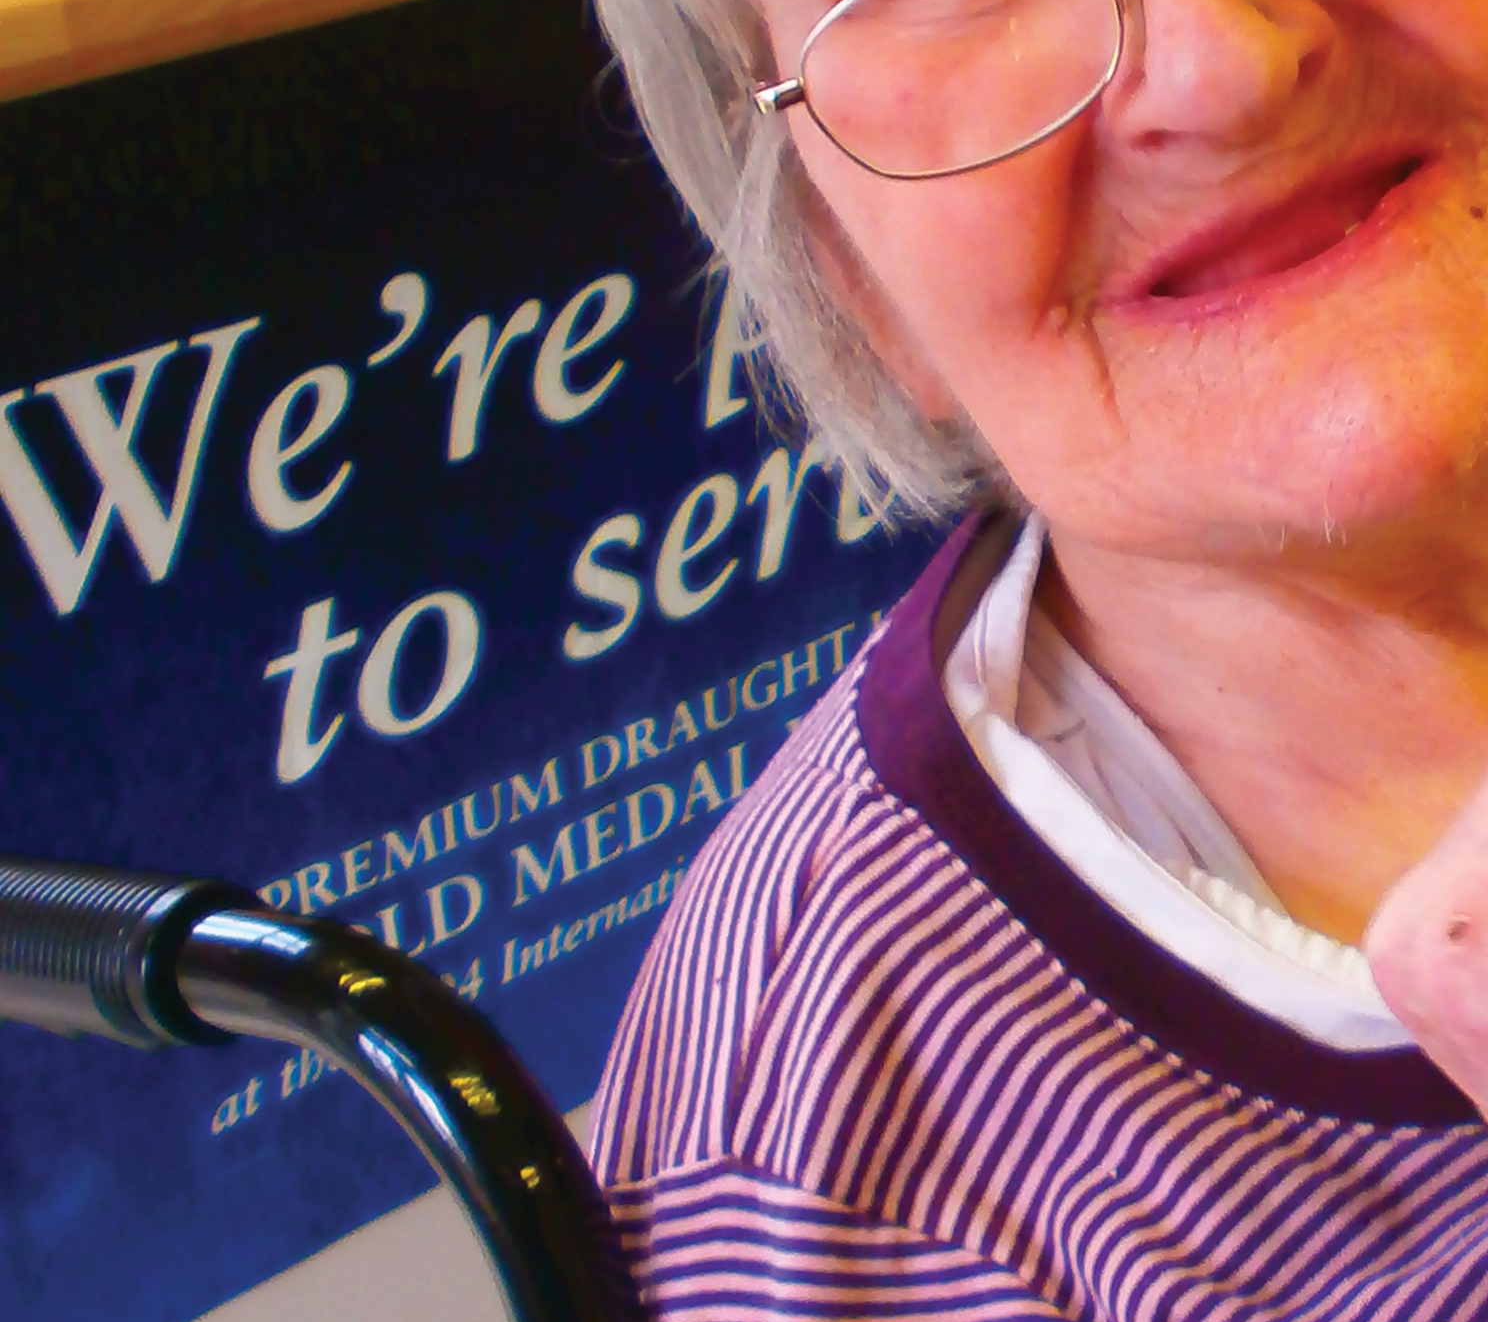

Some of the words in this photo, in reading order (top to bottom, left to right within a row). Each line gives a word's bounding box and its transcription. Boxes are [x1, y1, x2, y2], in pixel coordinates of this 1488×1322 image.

[0, 271, 633, 616] We're
[256, 755, 563, 917] PREMIUM
[581, 621, 856, 790] DRAUGHT
[263, 590, 480, 784] to
[211, 1076, 263, 1135] at
[279, 1048, 338, 1100] th
